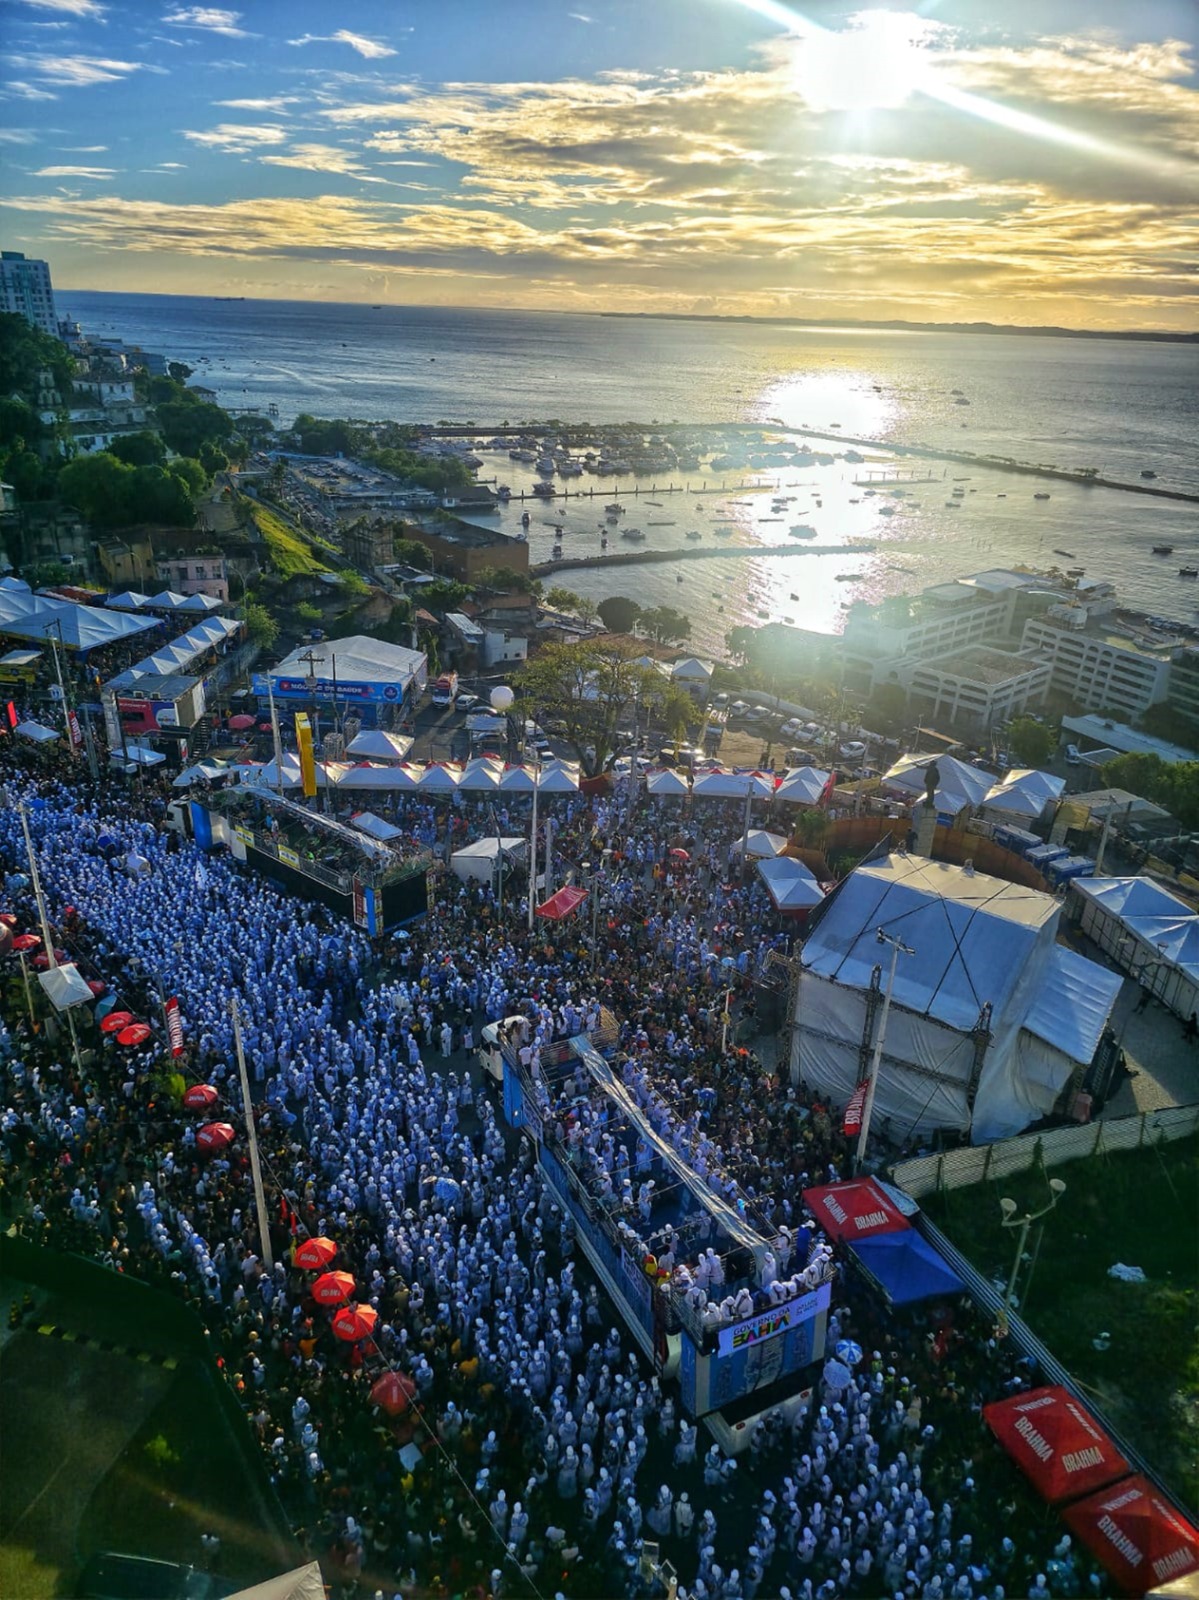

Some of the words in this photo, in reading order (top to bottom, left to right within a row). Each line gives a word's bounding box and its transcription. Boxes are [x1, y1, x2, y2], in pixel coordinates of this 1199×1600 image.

[823, 1194, 848, 1225] BRAHMA
[854, 1210, 889, 1230] BRAHMA
[733, 1313, 777, 1336] GOVERNO
[1014, 1415, 1054, 1462] BRAHMA
[1061, 1446, 1104, 1473] BRAHMA
[1097, 1514, 1143, 1568] BRAHMA
[1152, 1546, 1196, 1582] BRAHMA
